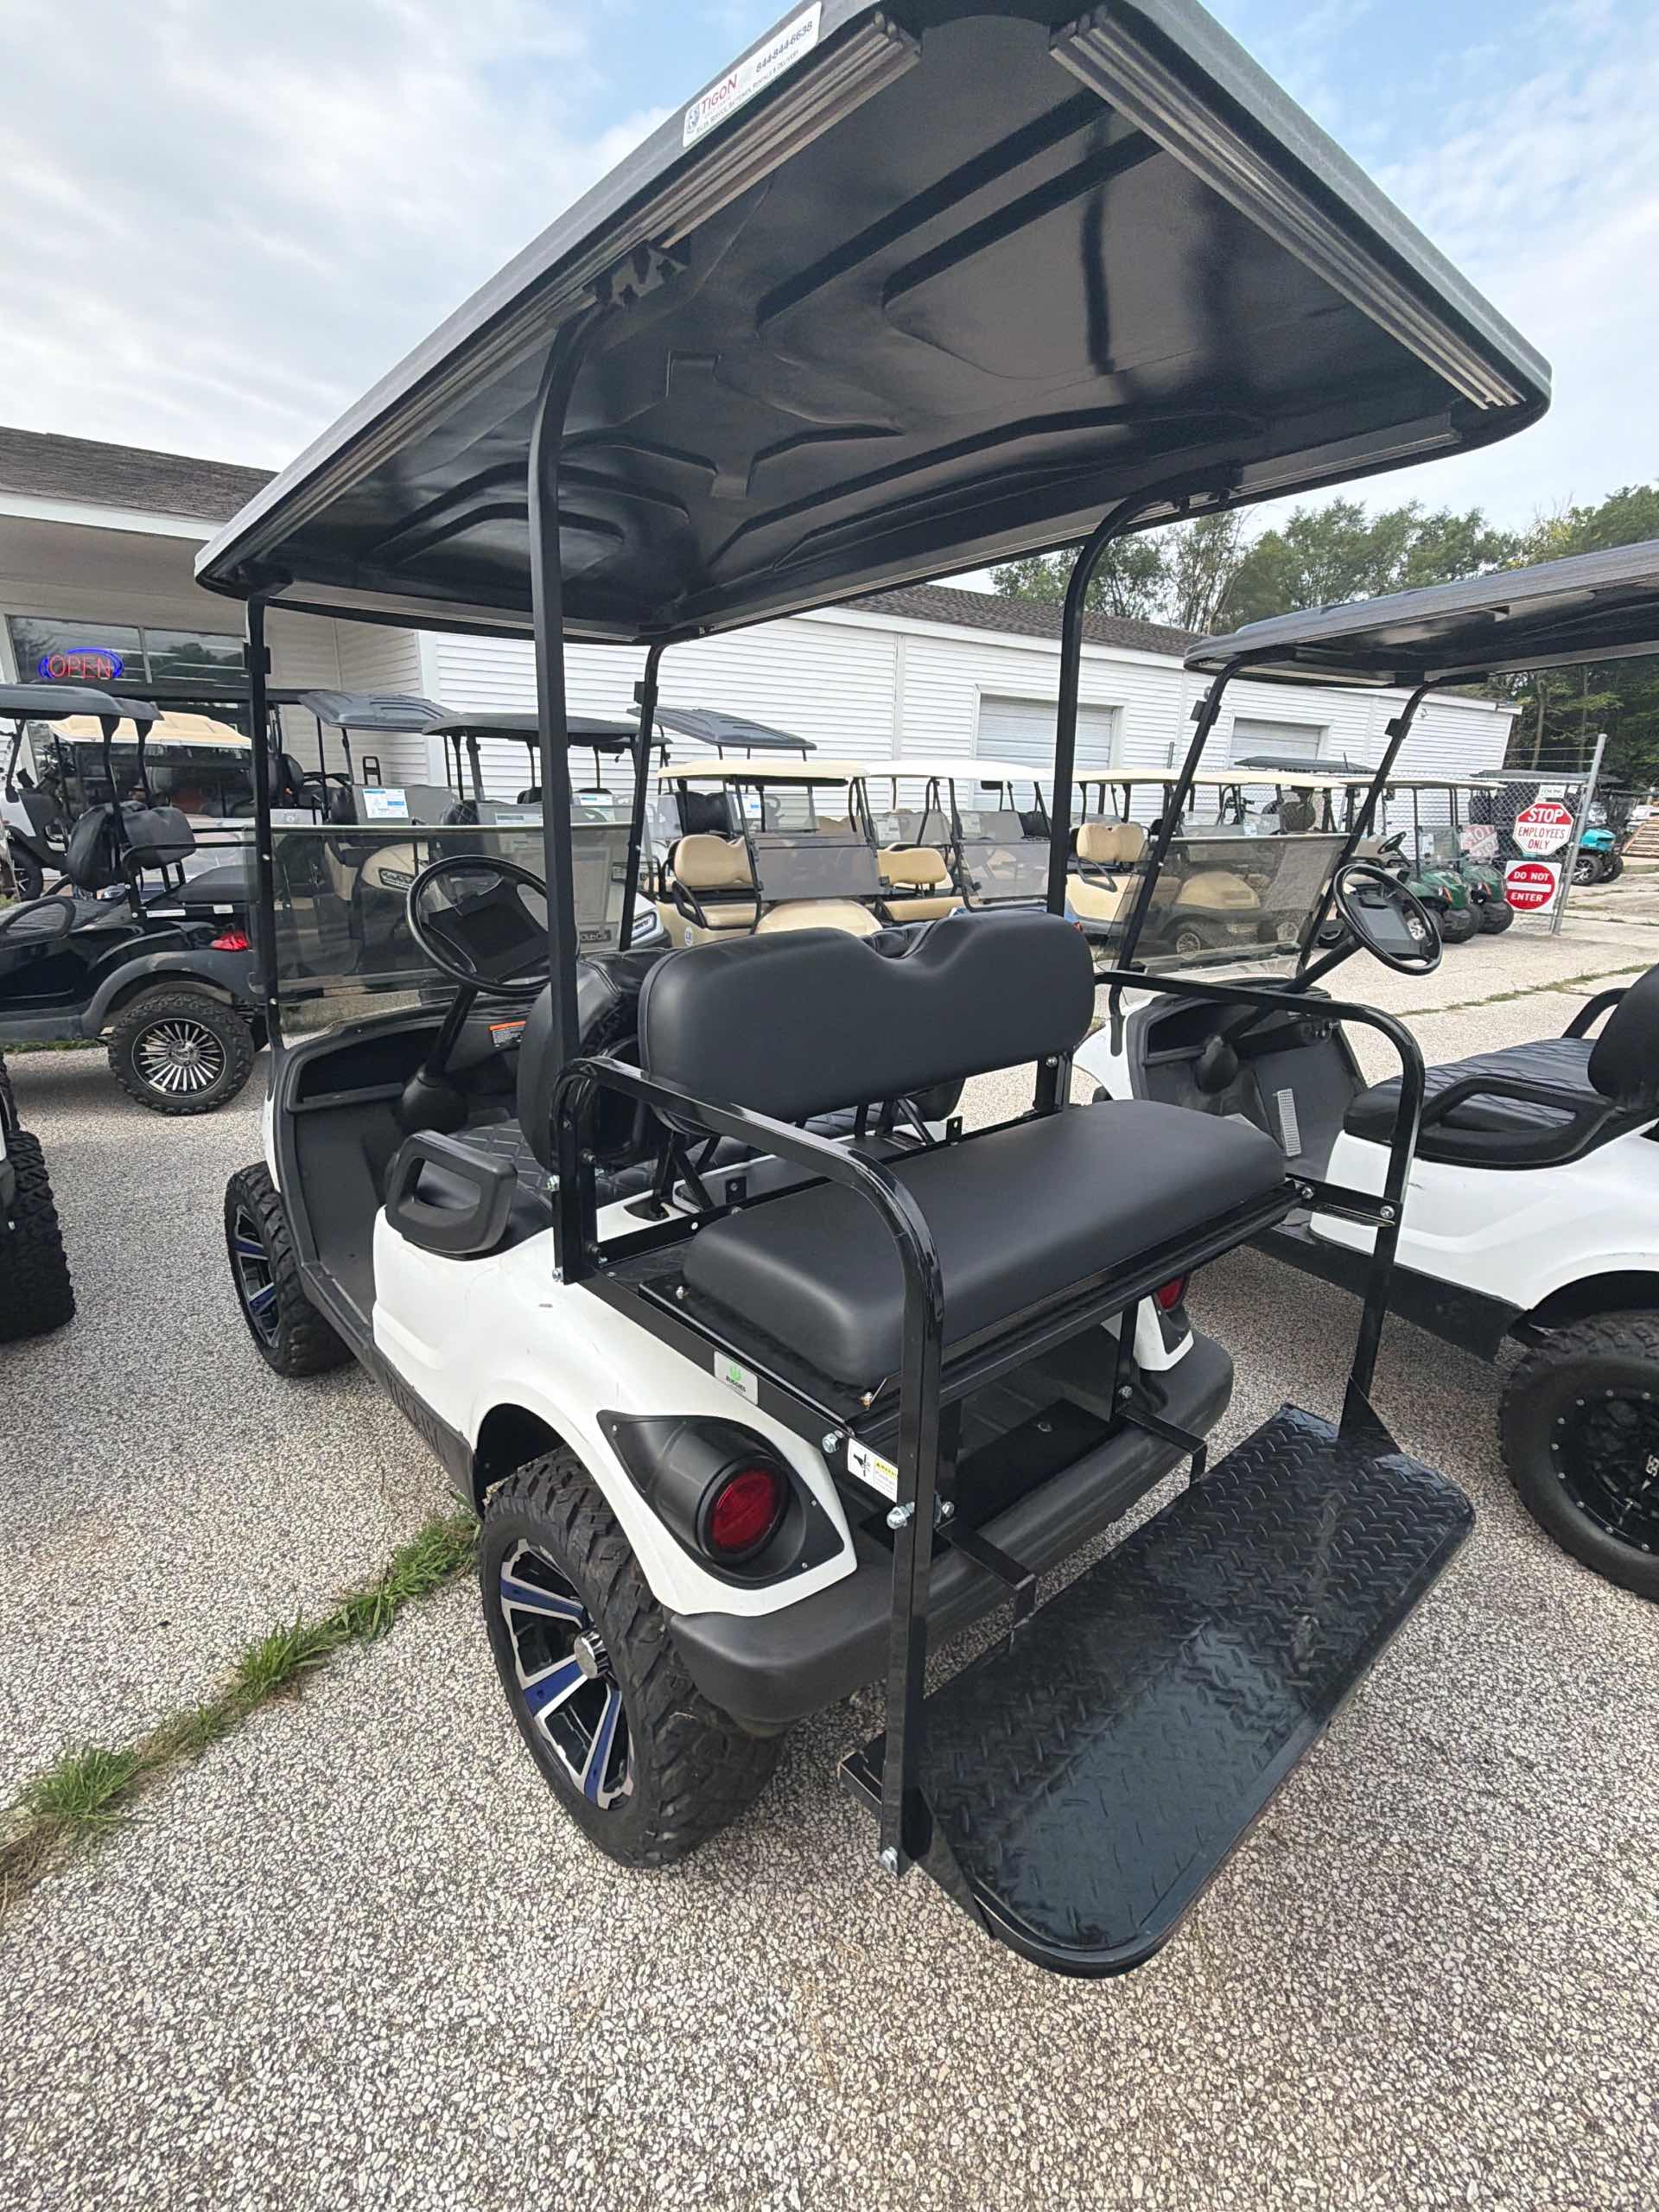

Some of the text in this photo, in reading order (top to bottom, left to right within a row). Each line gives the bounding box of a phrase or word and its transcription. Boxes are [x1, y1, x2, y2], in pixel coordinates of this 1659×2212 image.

[702, 73, 737, 113] TIGON
[49, 654, 111, 678] OPEN
[1528, 807, 1564, 823] STOP
[1518, 826, 1565, 839] EMPLOYEES
[1528, 838, 1549, 850] ONLY
[1514, 871, 1550, 881] DO NOT
[1510, 892, 1543, 902] ENTER
